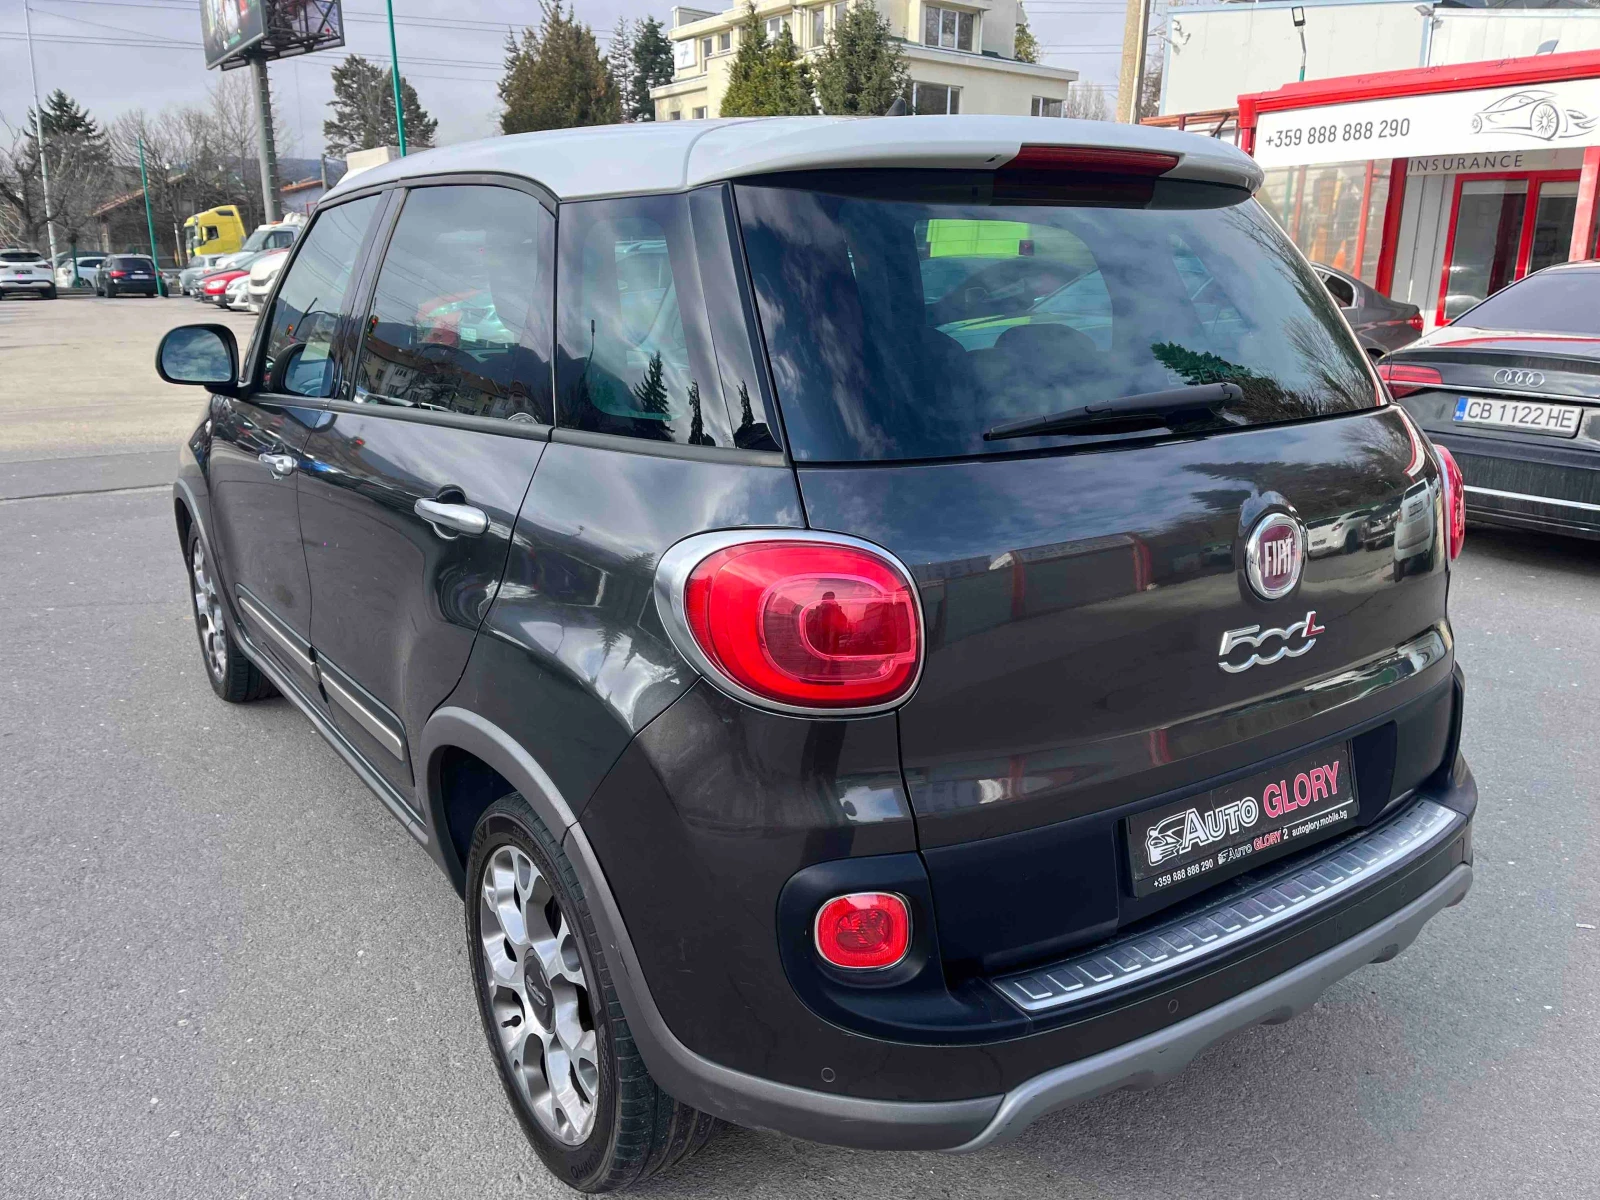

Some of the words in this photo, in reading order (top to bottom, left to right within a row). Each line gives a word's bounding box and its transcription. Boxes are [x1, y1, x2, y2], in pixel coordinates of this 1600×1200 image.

[1266, 127, 1302, 148] +359
[1307, 124, 1337, 145] 888
[1342, 121, 1373, 142] 888
[1378, 118, 1411, 139] 290
[1409, 154, 1524, 172] INSURANCE
[1468, 402, 1492, 420] CB
[1499, 404, 1544, 425] 1122
[1546, 408, 1575, 429] HE
[1263, 537, 1294, 578] FIAT
[1263, 760, 1340, 819] GLORY
[1153, 874, 1172, 889] +359
[1172, 869, 1186, 882] 888
[1187, 864, 1200, 878] 888
[1201, 859, 1214, 873] 290
[1253, 830, 1282, 850] GLORY
[1282, 829, 1289, 840] 2
[1292, 809, 1348, 837] autoglory.mobile.bg
